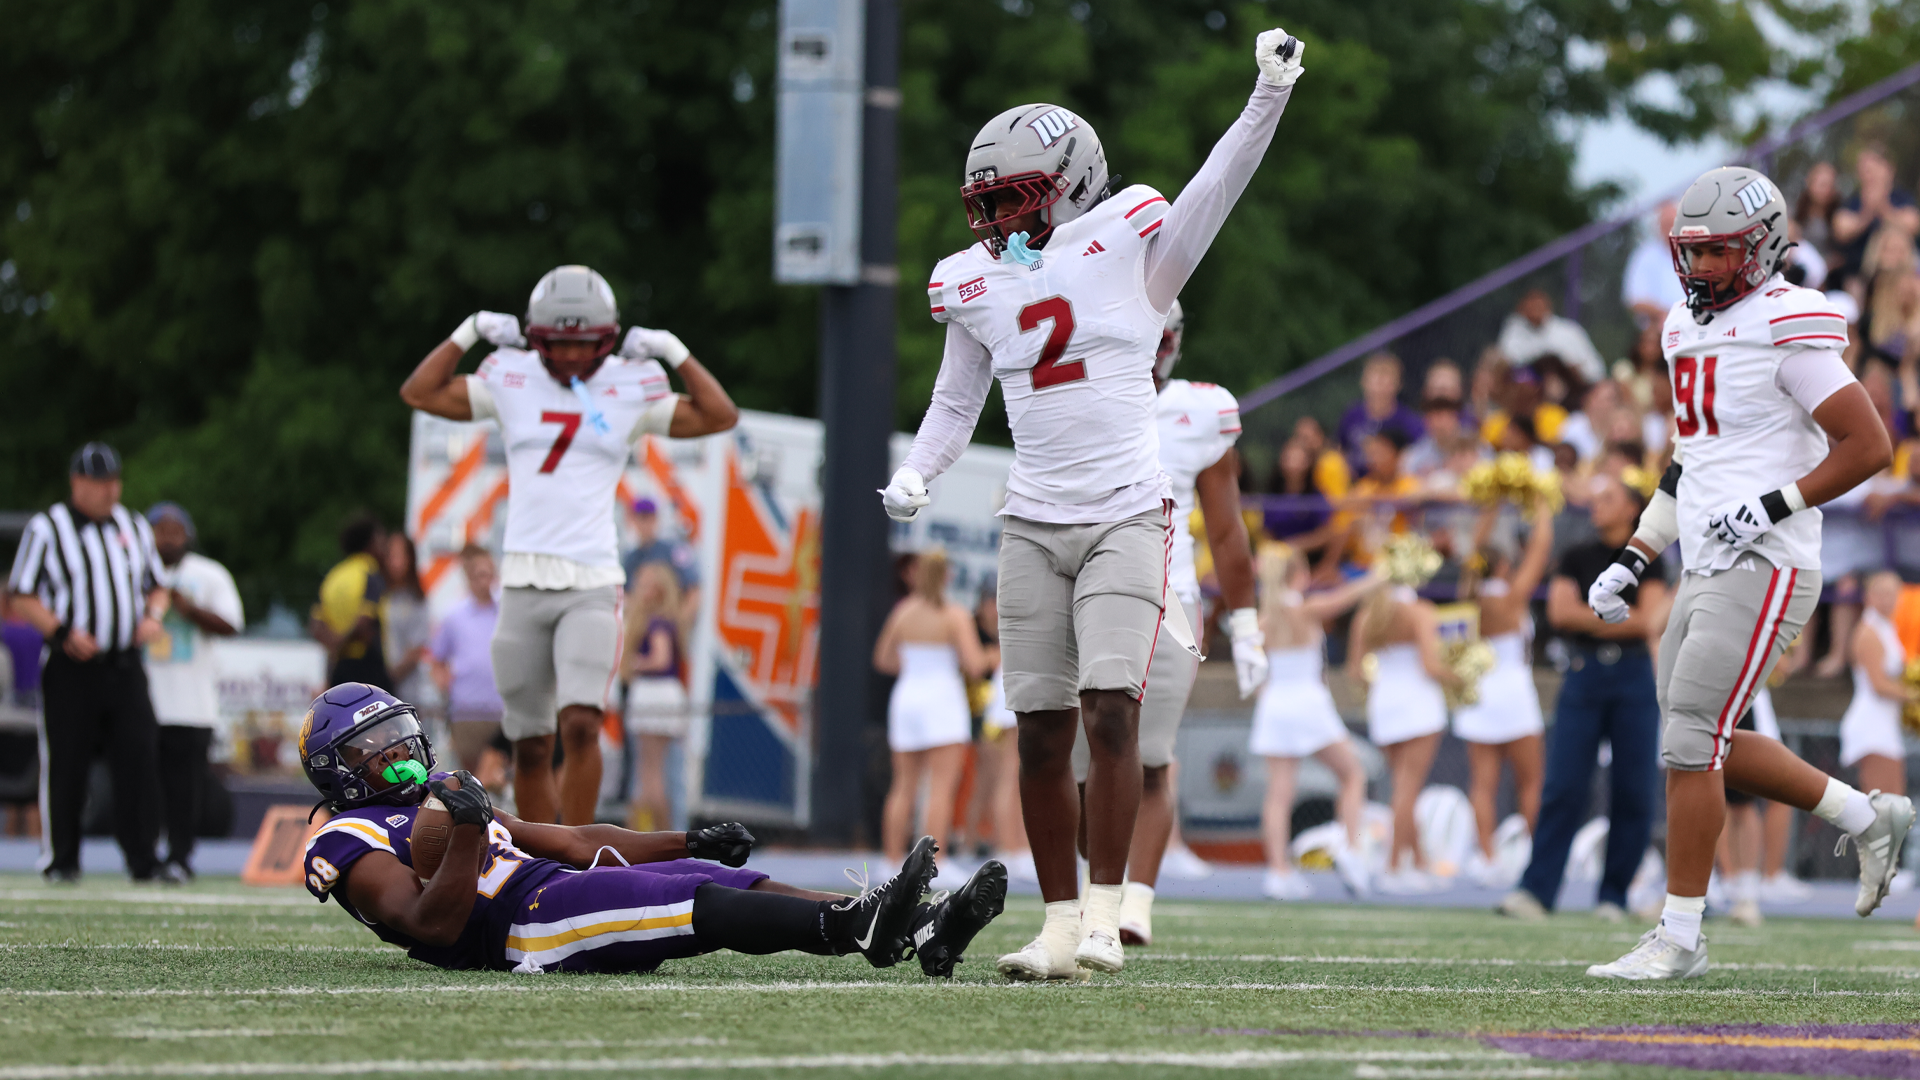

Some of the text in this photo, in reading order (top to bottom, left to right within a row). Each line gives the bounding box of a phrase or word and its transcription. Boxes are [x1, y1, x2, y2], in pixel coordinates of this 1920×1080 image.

[1027, 107, 1078, 148] IUP
[1735, 177, 1775, 218] IUP
[1029, 260, 1045, 272] IUP
[958, 281, 988, 300] PSAC
[1016, 293, 1089, 392] 2
[1674, 354, 1720, 437] 91
[538, 409, 582, 474] 7
[359, 702, 380, 717] WCU
[309, 855, 341, 894] 28
[913, 919, 936, 952] NIKE
